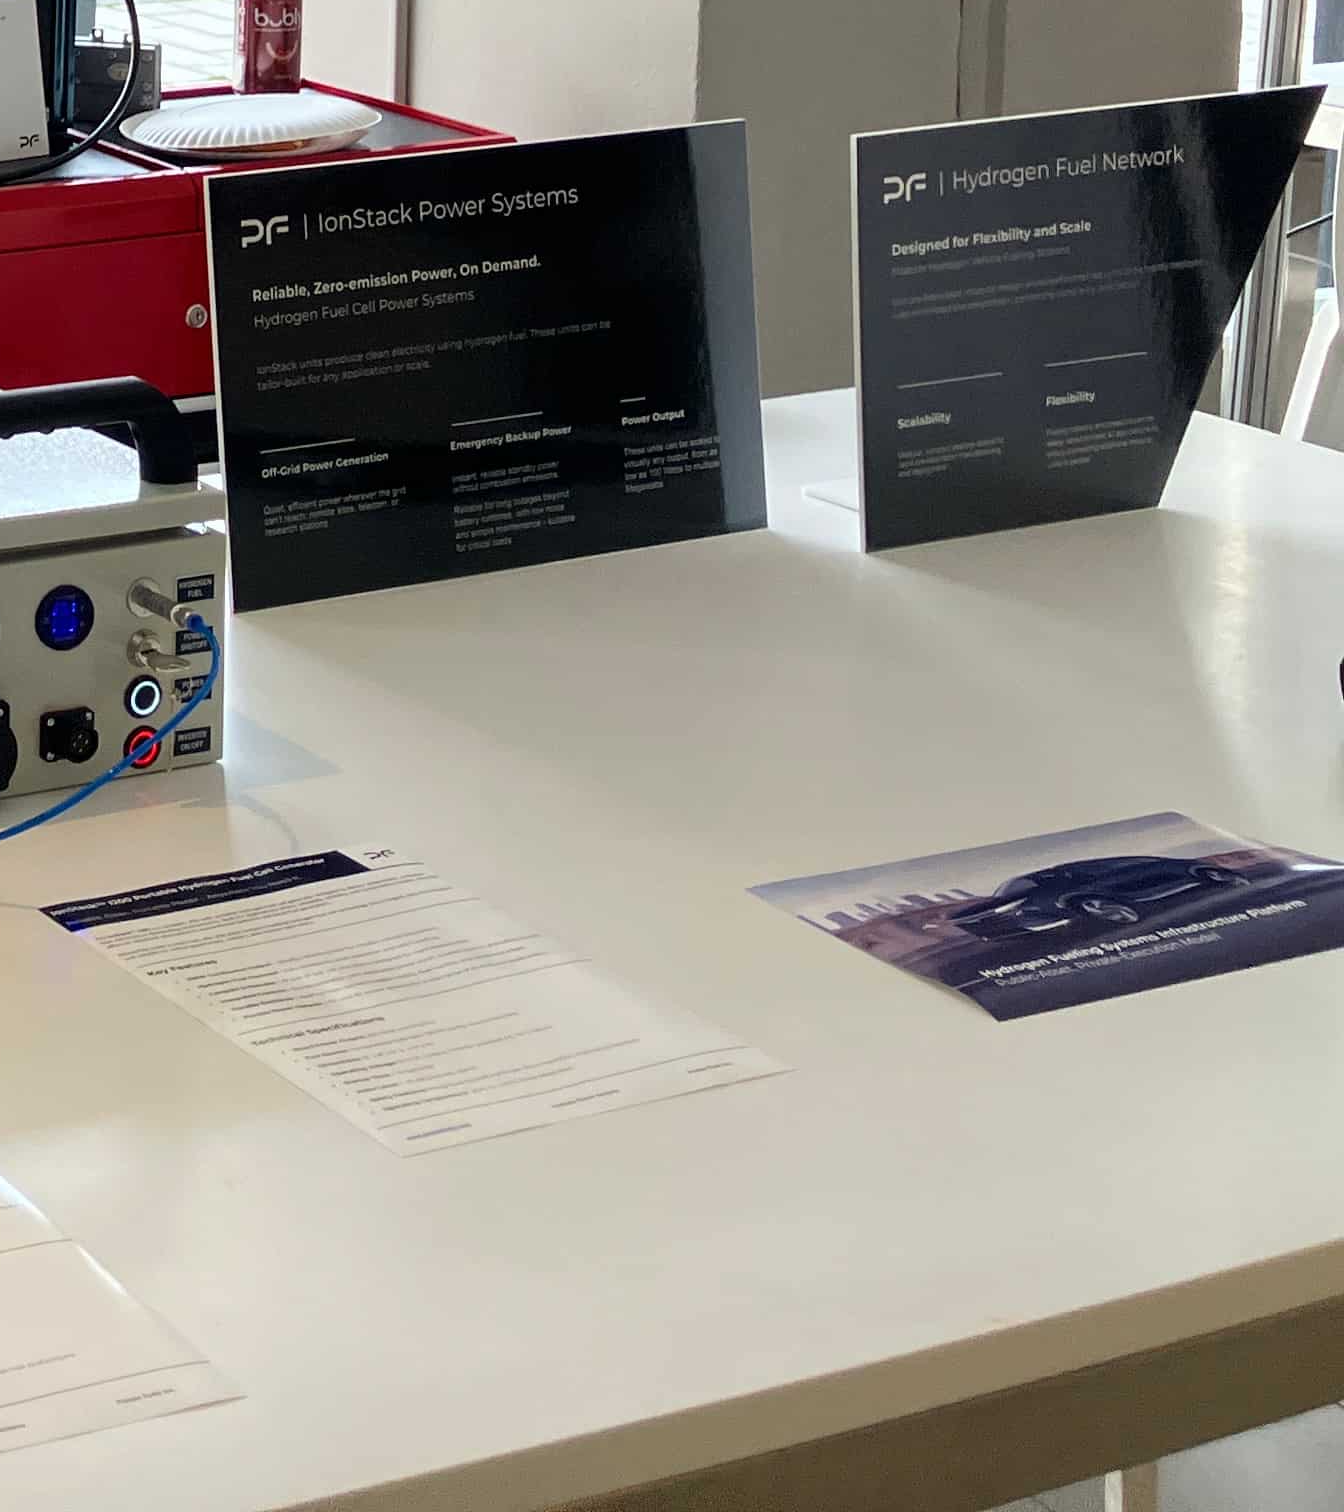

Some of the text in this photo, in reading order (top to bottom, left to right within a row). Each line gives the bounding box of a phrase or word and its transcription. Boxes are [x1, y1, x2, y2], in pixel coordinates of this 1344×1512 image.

[255, 7, 300, 28] bubl
[953, 164, 1050, 194] Hydrogen
[1056, 154, 1097, 177] Fuel
[1102, 145, 1185, 171] Network
[318, 203, 413, 234] IonStack
[419, 196, 486, 222] Power
[491, 188, 580, 216] Systems
[891, 220, 1092, 257] Designed for Flexibility and Scale
[252, 254, 542, 303] Reliable, Zero-emission Power, On Demand.
[254, 289, 475, 330] Hydrogen Fuel Cell Power Systems
[1045, 390, 1096, 407] Flexibility
[621, 409, 685, 427] Power Output
[897, 411, 952, 431] Scalability
[449, 425, 572, 452] Emergency Backup Power
[261, 452, 389, 479] Off-Grid Power Generation
[979, 955, 1049, 979] Hydrogen
[1102, 933, 1157, 953] Systems
[1158, 912, 1249, 939] Infrastructure
[1247, 899, 1308, 919] Platform
